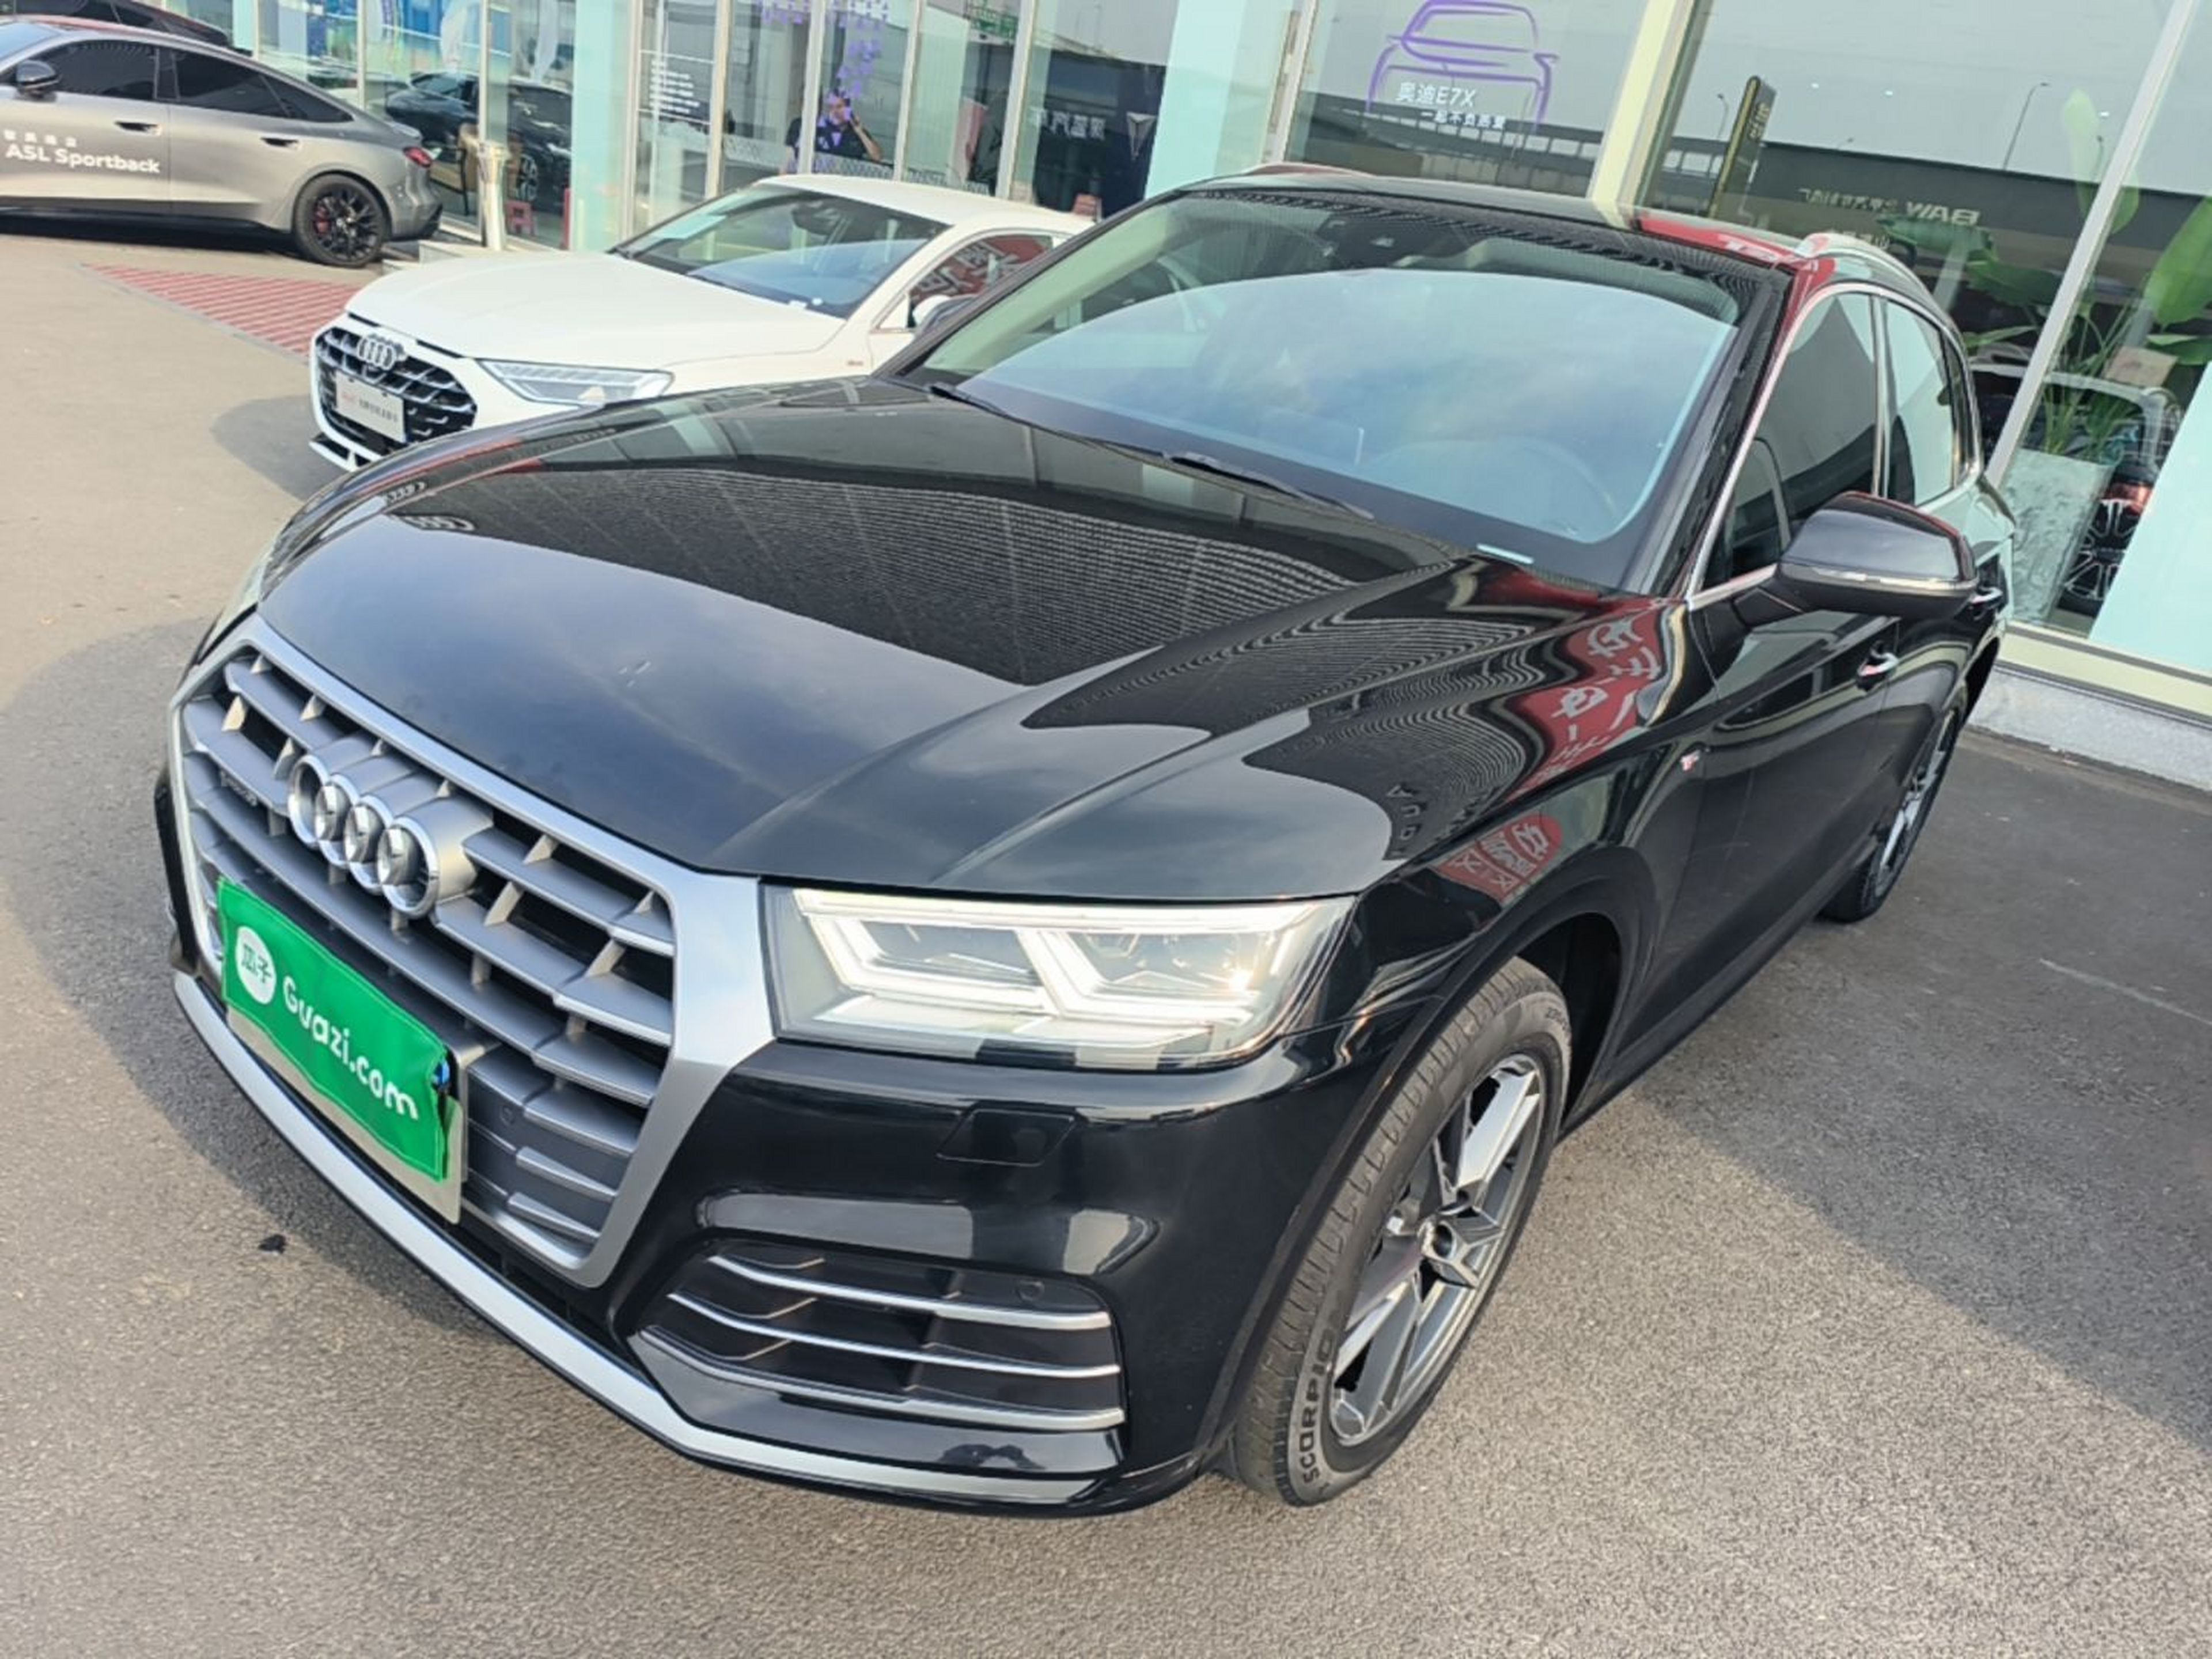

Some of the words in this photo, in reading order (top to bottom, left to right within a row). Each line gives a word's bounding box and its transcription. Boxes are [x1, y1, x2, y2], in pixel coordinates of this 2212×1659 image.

[55, 147, 161, 173] Sportback
[241, 944, 272, 984] 瓜子
[283, 976, 419, 1120] Guazi.com
